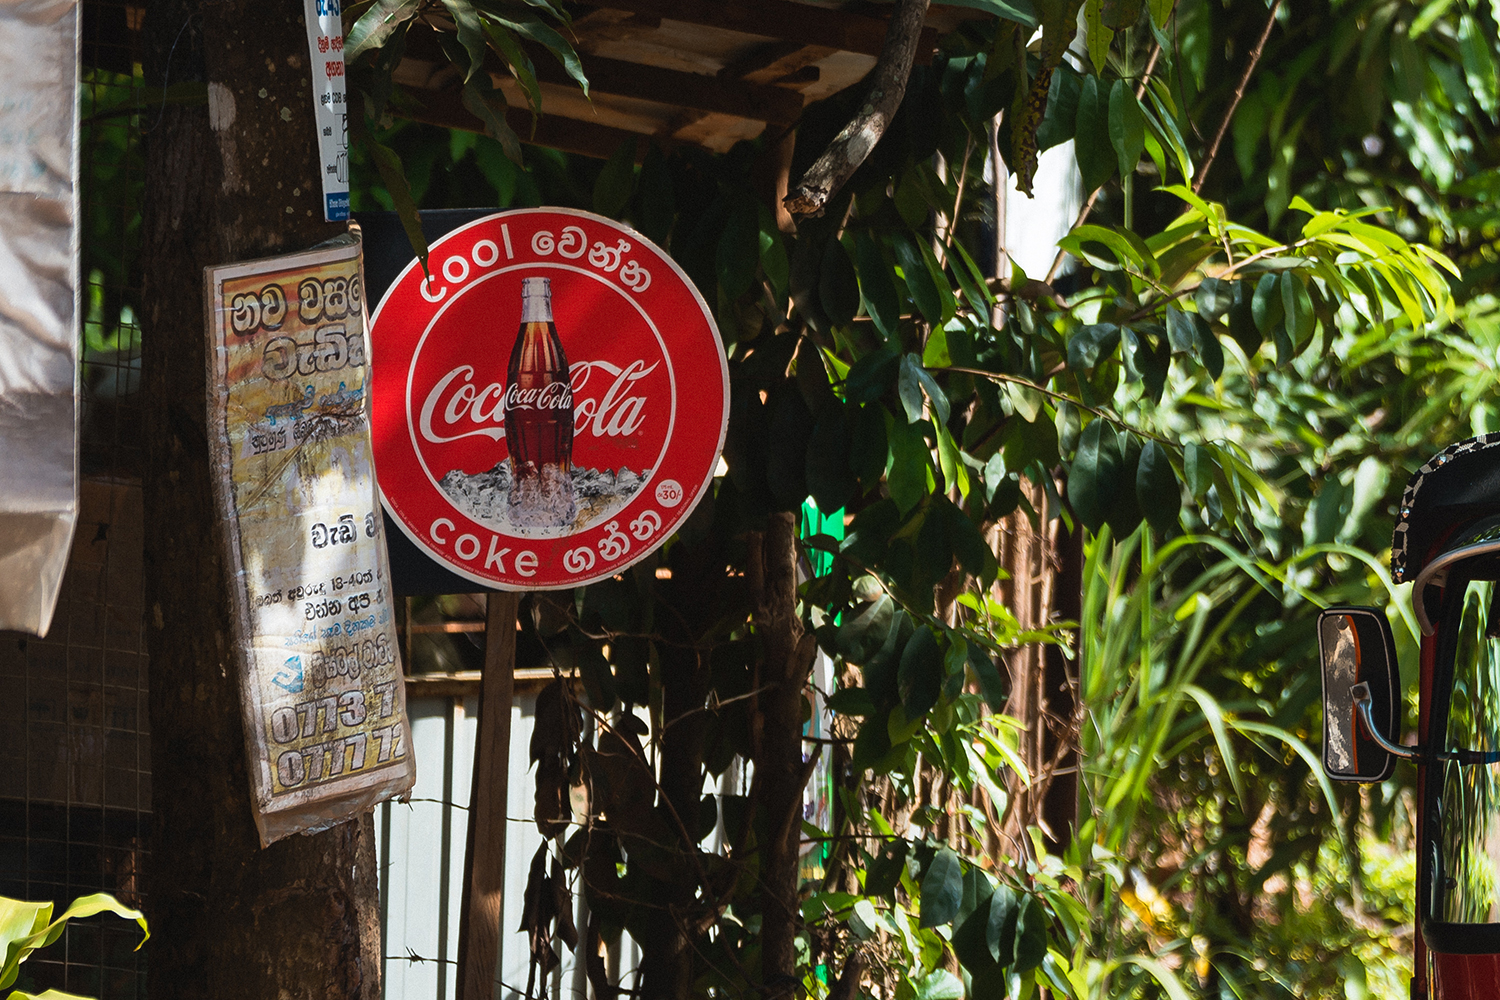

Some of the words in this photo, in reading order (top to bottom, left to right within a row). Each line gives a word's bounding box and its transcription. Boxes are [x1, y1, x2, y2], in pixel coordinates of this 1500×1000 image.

[419, 222, 515, 303] cool
[531, 225, 652, 293] වෙන්න
[429, 517, 539, 577] coke
[562, 509, 663, 574] ගන්න
[270, 689, 367, 744] 0773
[373, 679, 398, 720] 7
[276, 732, 368, 788] 0777
